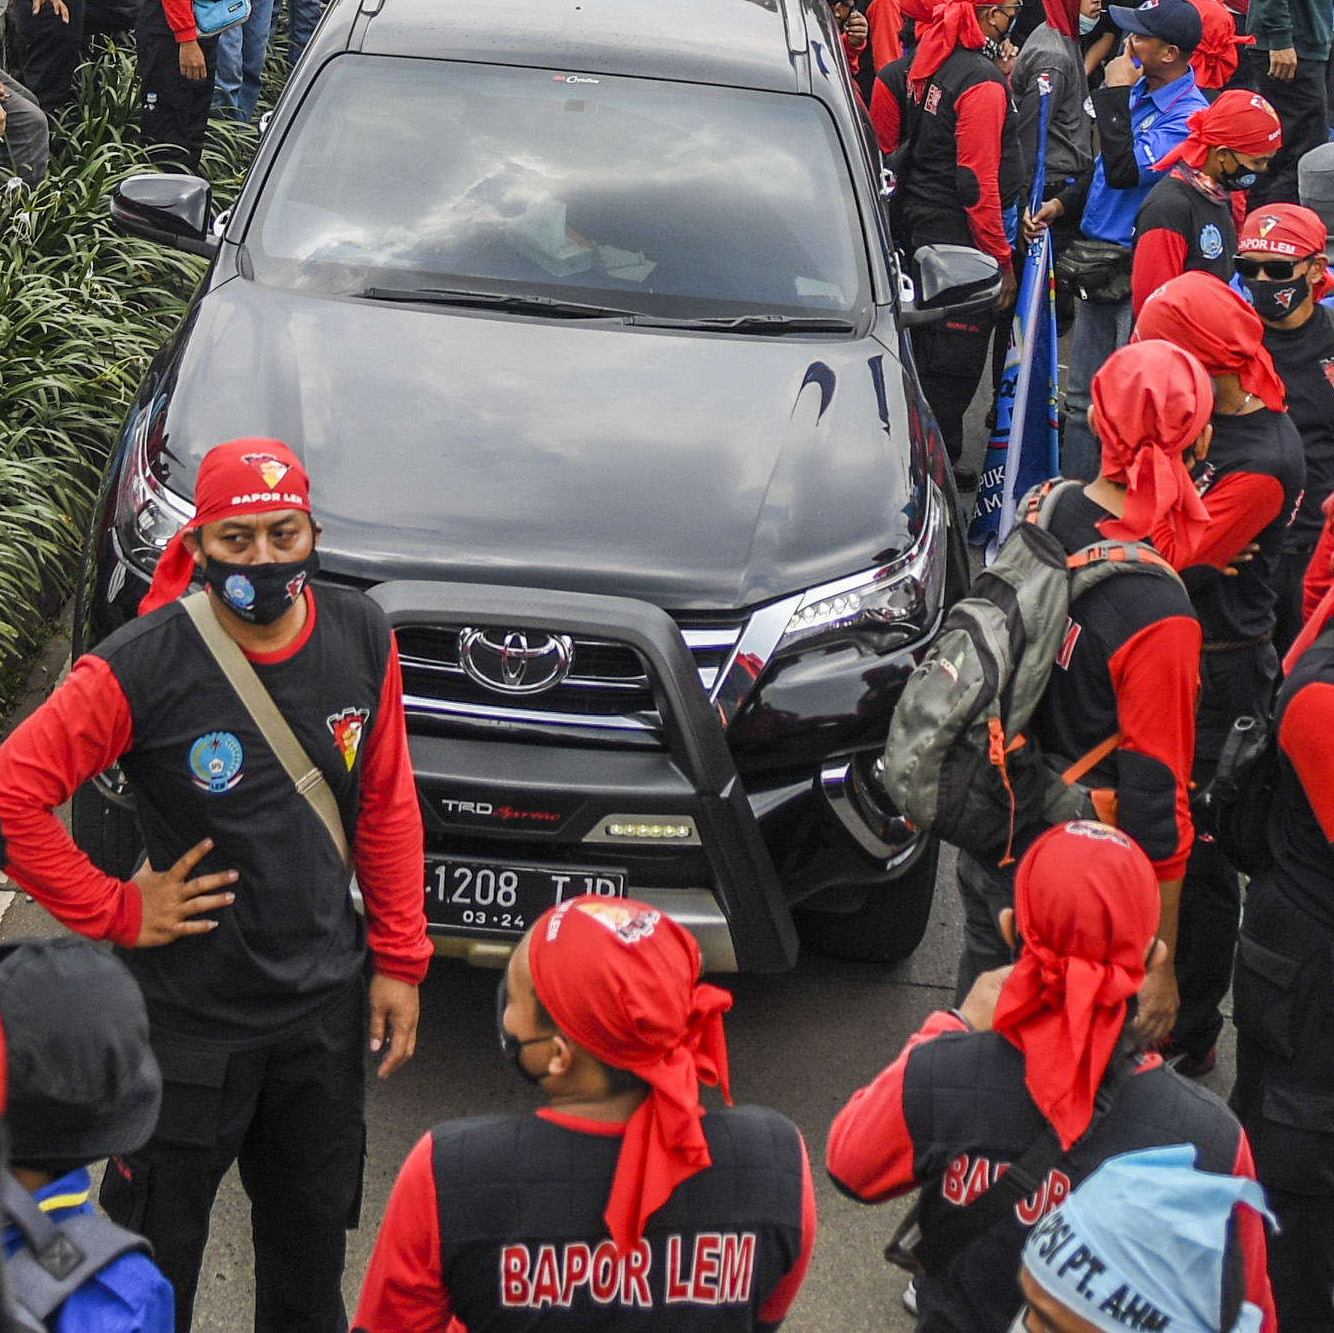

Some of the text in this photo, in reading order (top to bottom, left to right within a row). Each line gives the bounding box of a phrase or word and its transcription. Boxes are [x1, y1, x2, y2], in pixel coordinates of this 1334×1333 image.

[1269, 240, 1296, 255] LEM
[231, 492, 281, 506] BAPOR
[211, 780, 227, 790] LEM
[442, 798, 493, 815] TRD
[434, 865, 519, 907] 1208
[500, 1232, 756, 1309] BAPOR LEM
[1057, 1243, 1108, 1300] PT.
